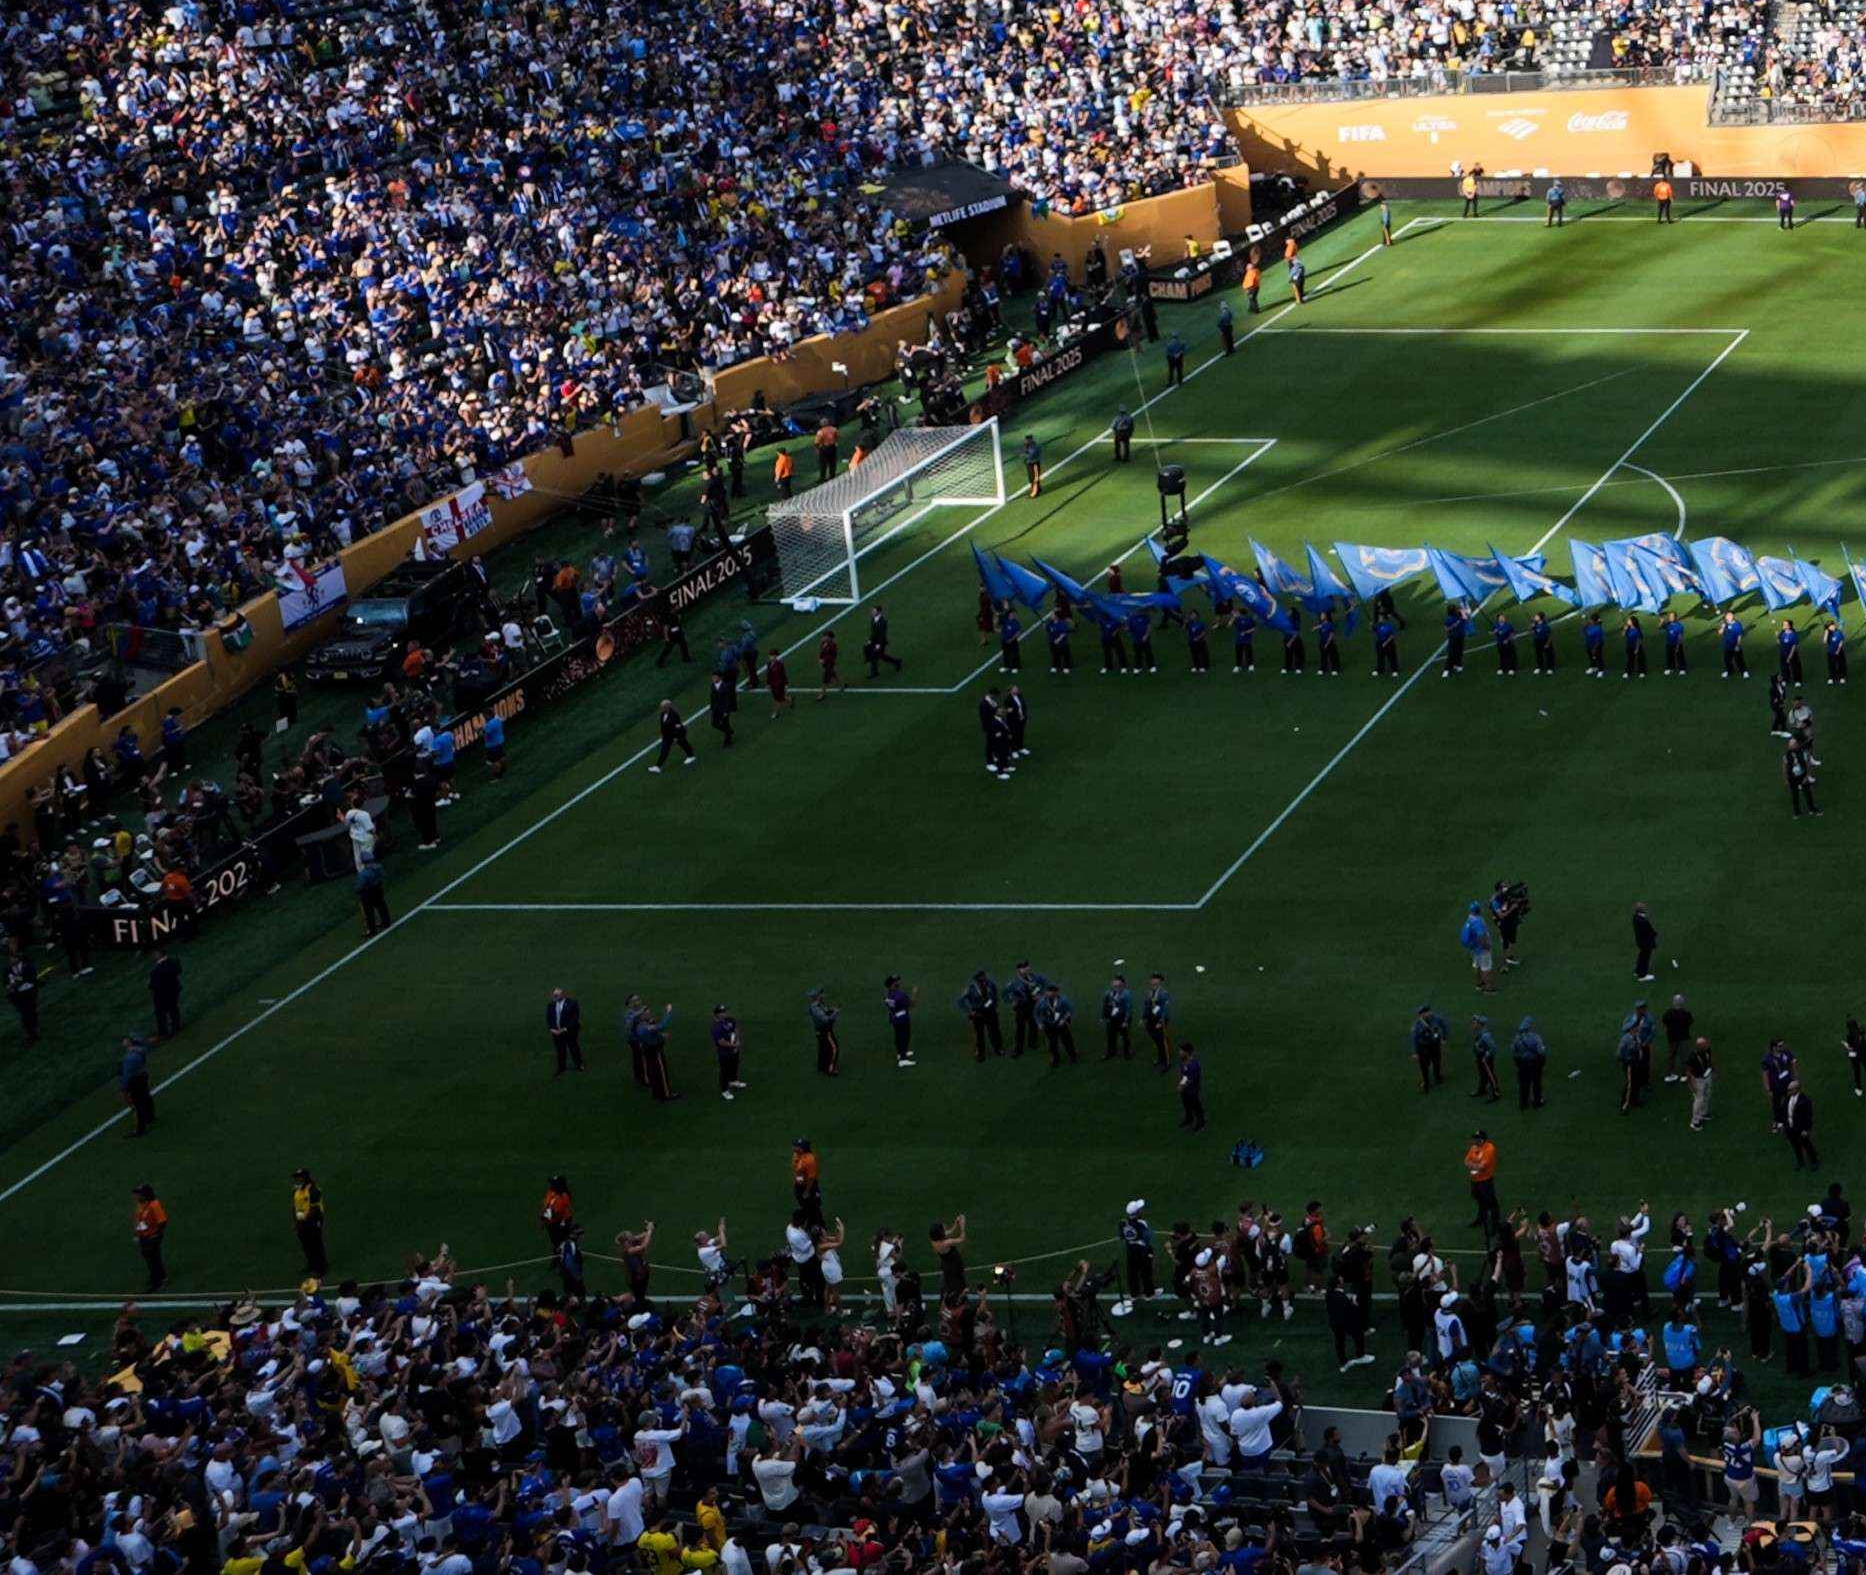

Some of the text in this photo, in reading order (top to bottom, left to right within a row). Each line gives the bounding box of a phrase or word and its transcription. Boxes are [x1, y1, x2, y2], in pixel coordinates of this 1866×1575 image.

[1338, 126, 1386, 143] FIFA
[1690, 182, 1742, 197] FINAL
[929, 206, 967, 228] METLIFE
[1149, 271, 1212, 299] CHAMIONS
[1020, 345, 1083, 396] FINAL 2025
[670, 544, 753, 608] FINAL 205
[206, 861, 247, 906] 202
[1172, 1379, 1191, 1399] 10
